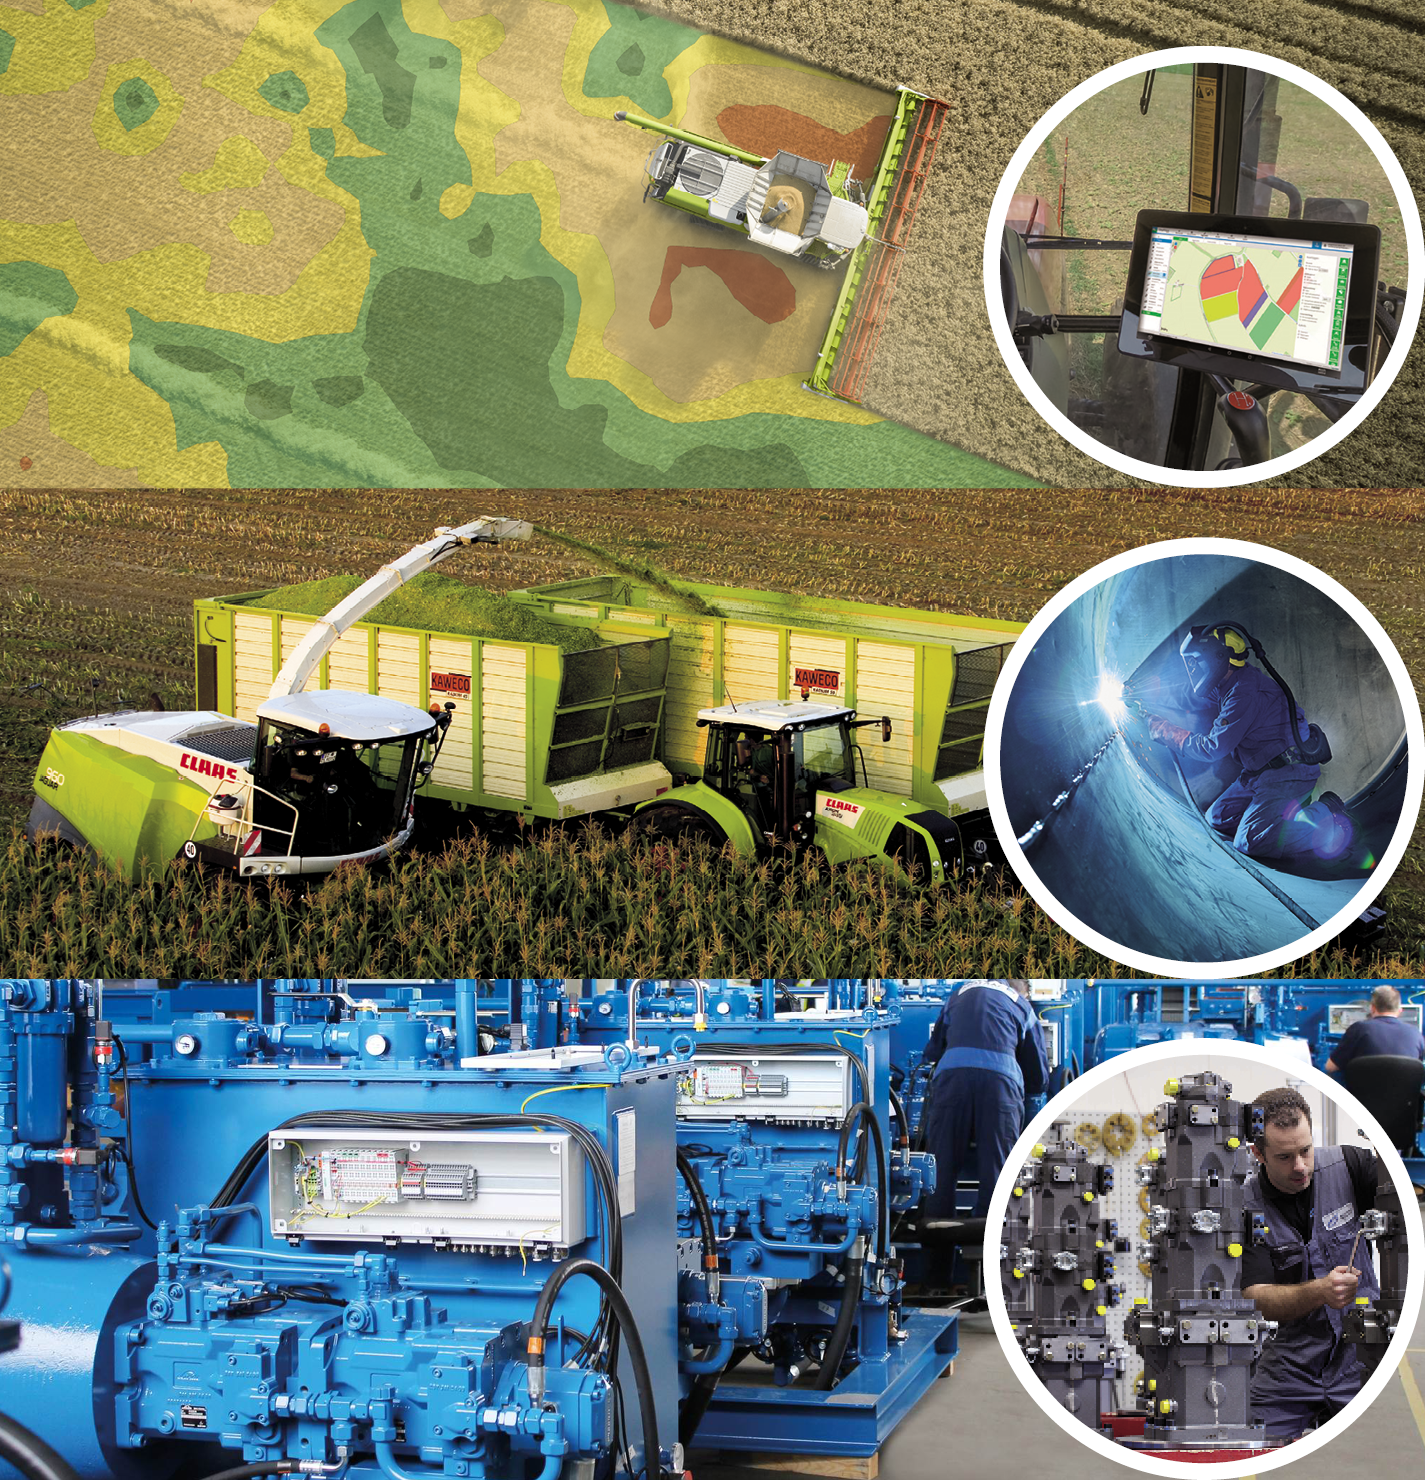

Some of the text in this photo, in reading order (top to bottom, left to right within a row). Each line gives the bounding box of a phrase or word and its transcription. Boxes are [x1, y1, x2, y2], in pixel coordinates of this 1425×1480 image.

[431, 674, 470, 692] KAWECO
[796, 670, 839, 688] KAWECO
[46, 766, 65, 786] 960
[180, 752, 238, 784] CLAAS
[826, 798, 859, 814] CLAAS
[187, 843, 195, 856] 40
[975, 841, 985, 852] 40
